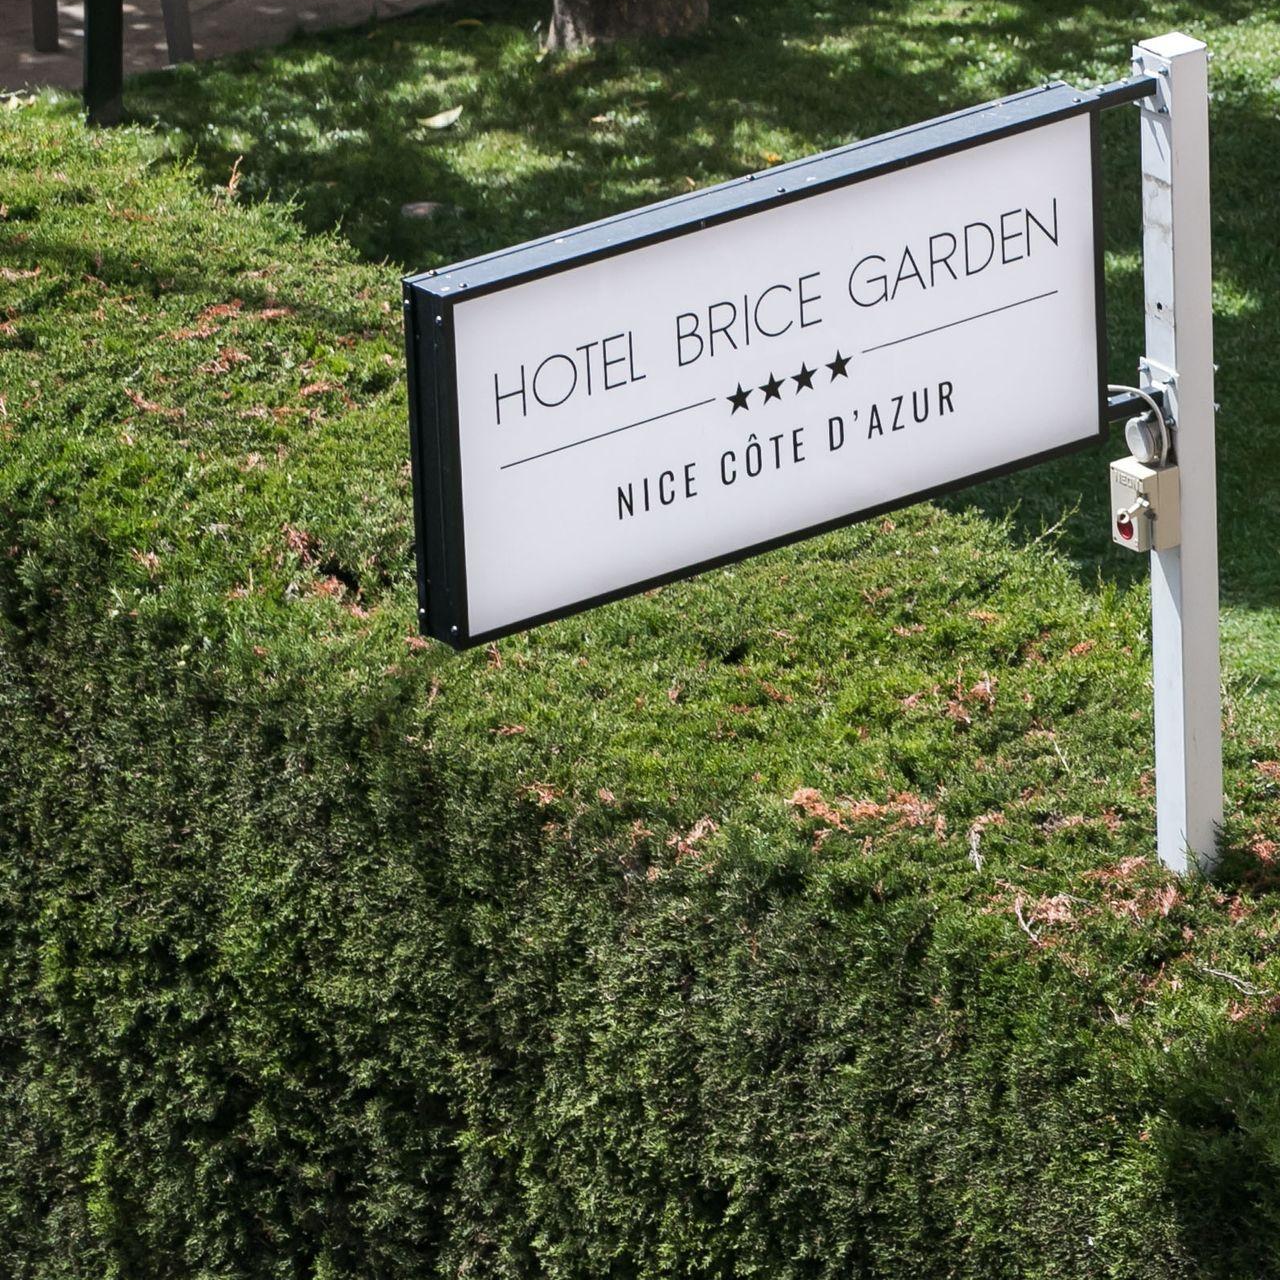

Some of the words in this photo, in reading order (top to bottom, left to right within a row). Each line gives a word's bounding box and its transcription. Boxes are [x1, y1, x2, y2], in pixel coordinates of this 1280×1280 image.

[494, 331, 647, 424] HOTEL
[676, 272, 823, 366] BRICE
[848, 198, 1059, 308] GARDEN
[618, 462, 698, 521] NICE
[720, 427, 806, 486] CÔTE
[828, 381, 956, 452] D'AZUR
